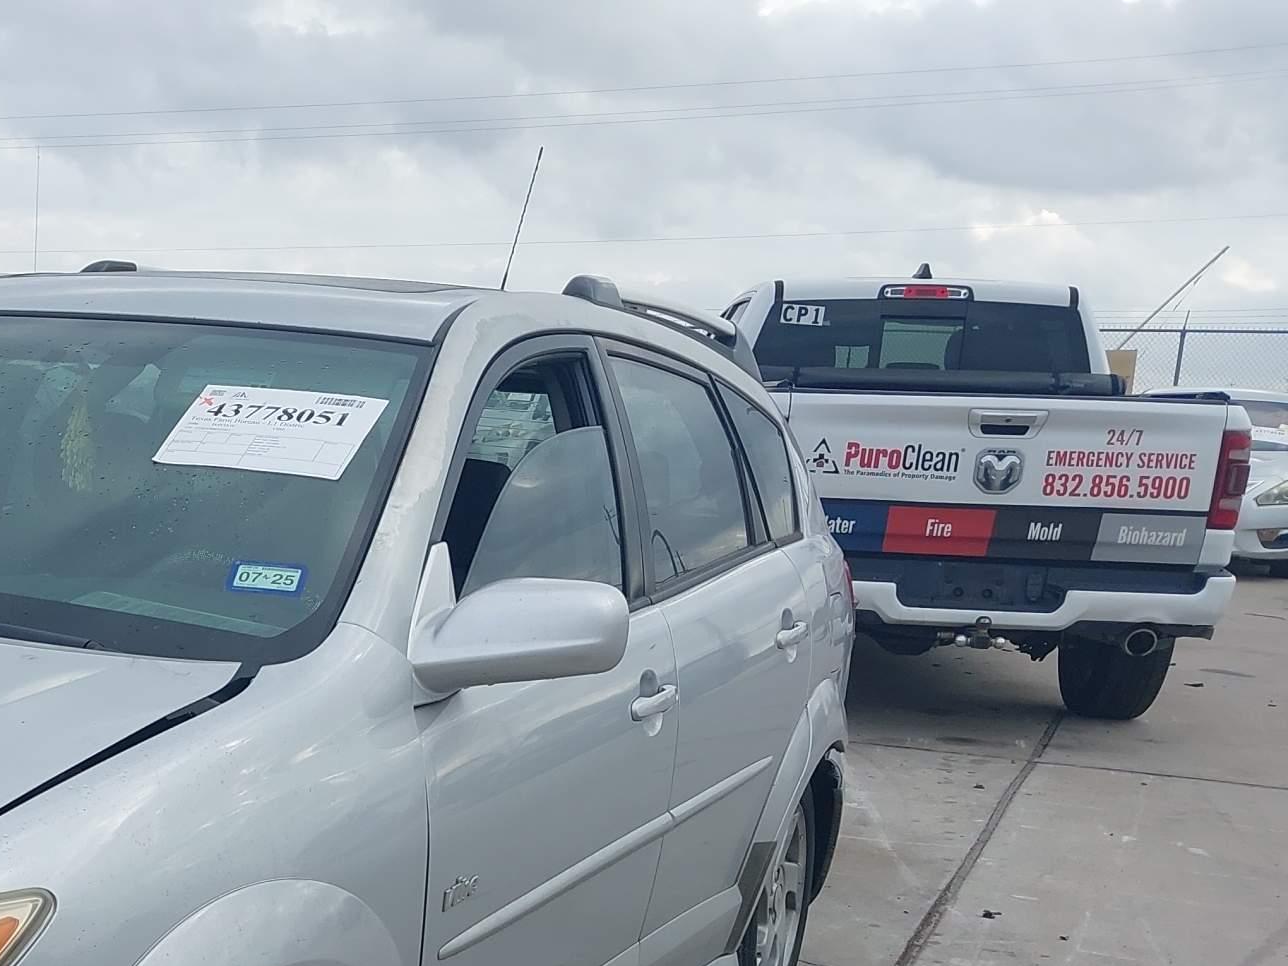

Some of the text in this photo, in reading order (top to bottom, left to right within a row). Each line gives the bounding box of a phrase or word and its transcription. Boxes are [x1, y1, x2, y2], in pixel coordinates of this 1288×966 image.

[782, 305, 821, 324] CP1
[206, 403, 350, 426] 43778051
[1106, 429, 1144, 446] 24/7
[844, 442, 960, 473] PuroClean
[1046, 450, 1197, 470] EMERGENCY SERVICE
[856, 470, 891, 479] Paramedics
[901, 472, 929, 481] Property
[930, 473, 956, 481] Damage
[1042, 474, 1191, 499] 832.856.5900
[825, 514, 856, 534] ater
[925, 518, 953, 537] Fire
[1027, 522, 1063, 542] Mold
[1118, 526, 1186, 547] Biohazard
[238, 571, 296, 586] 07 25
